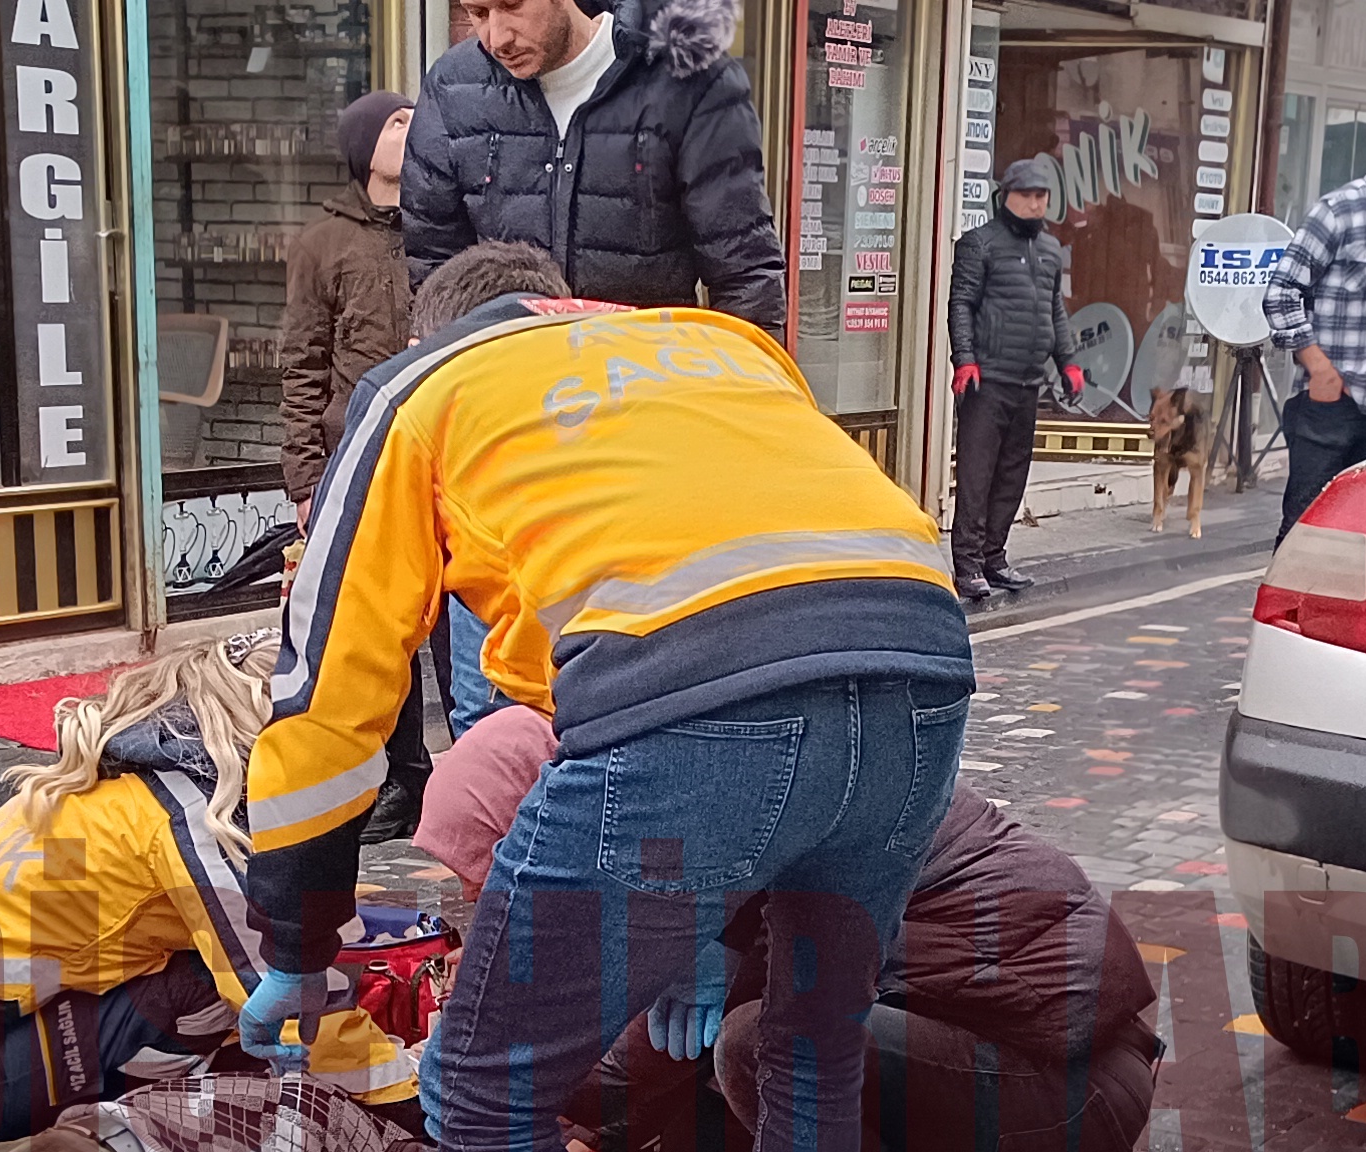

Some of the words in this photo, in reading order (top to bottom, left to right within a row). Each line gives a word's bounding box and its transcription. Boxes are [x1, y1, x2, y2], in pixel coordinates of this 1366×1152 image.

[859, 47, 872, 66] VE
[856, 252, 891, 272] VESTEL
[1232, 271, 1255, 285] 862
